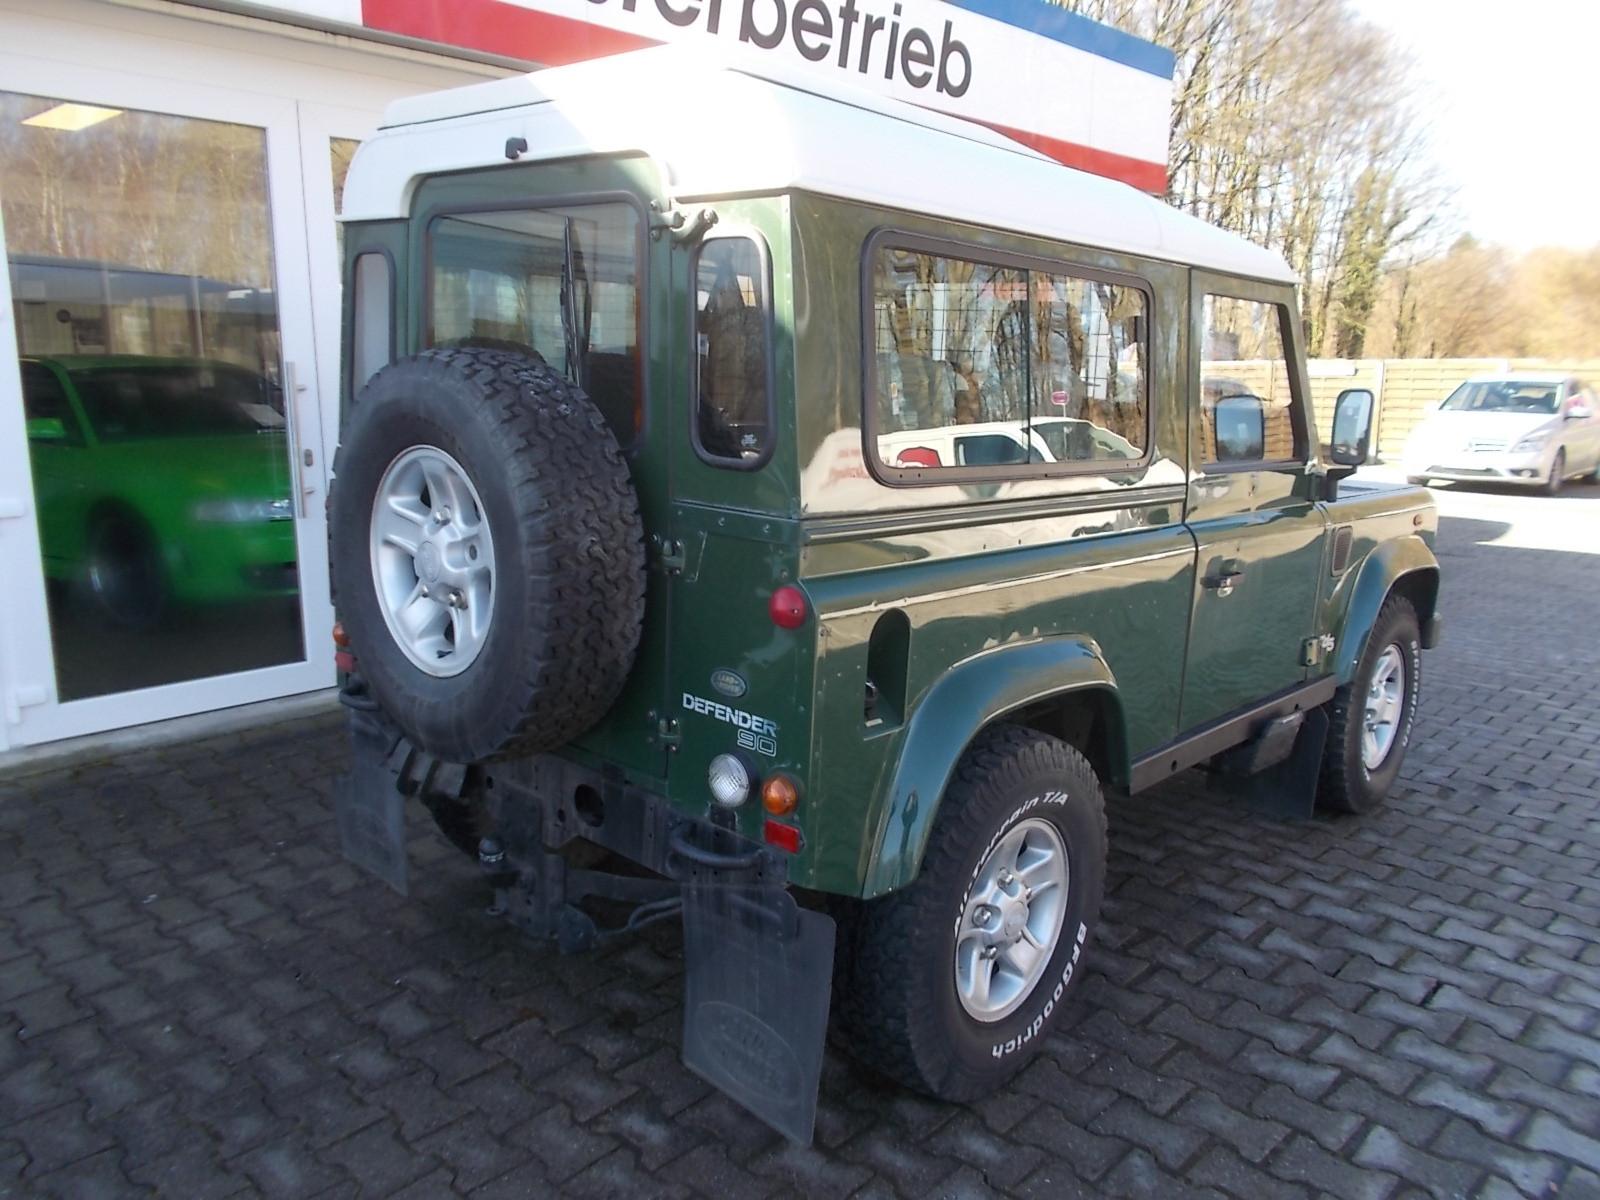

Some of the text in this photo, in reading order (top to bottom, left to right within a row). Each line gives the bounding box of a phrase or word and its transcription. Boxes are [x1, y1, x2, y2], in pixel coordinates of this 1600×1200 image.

[682, 692, 777, 737] DEFENDER
[737, 728, 777, 757] 90
[1042, 791, 1069, 805] T/A
[992, 921, 1088, 1059] BFGoodrich
